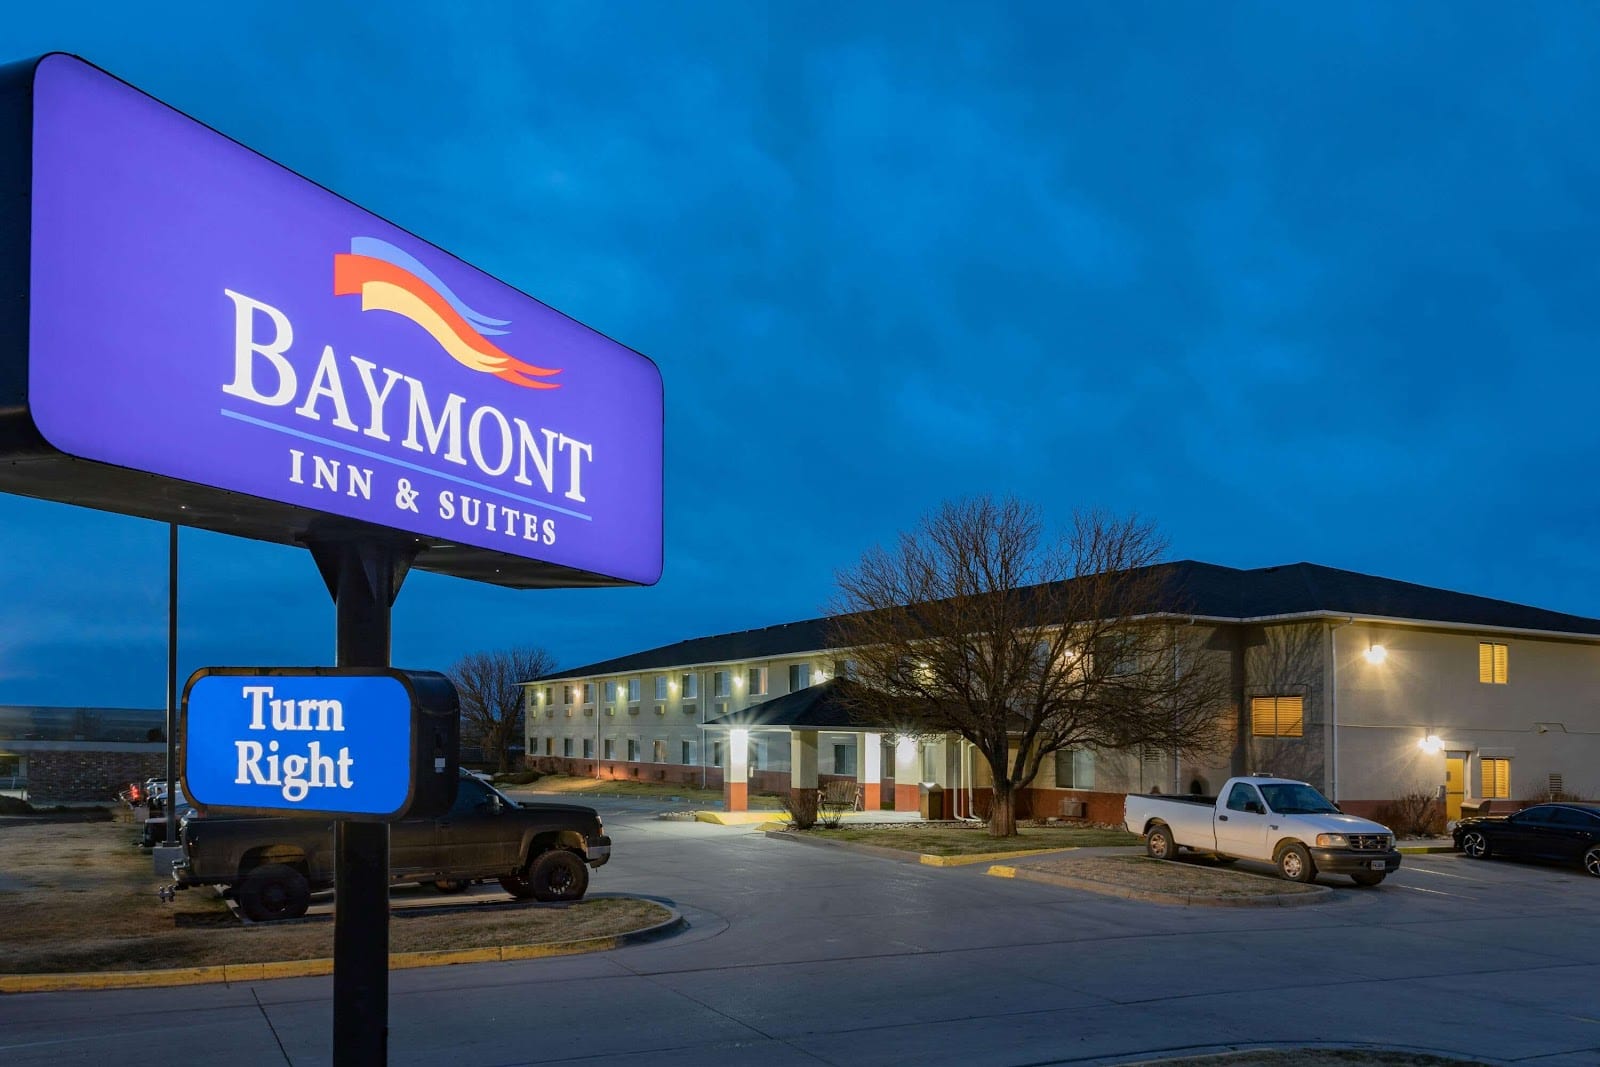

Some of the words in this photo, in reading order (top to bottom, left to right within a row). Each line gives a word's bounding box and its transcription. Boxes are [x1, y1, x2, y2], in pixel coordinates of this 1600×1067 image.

[222, 288, 593, 503] BAYMONT
[289, 448, 374, 500] INN
[395, 478, 420, 513] &
[439, 490, 557, 546] SUITES
[243, 686, 345, 731] Turn
[235, 740, 354, 802] Right
